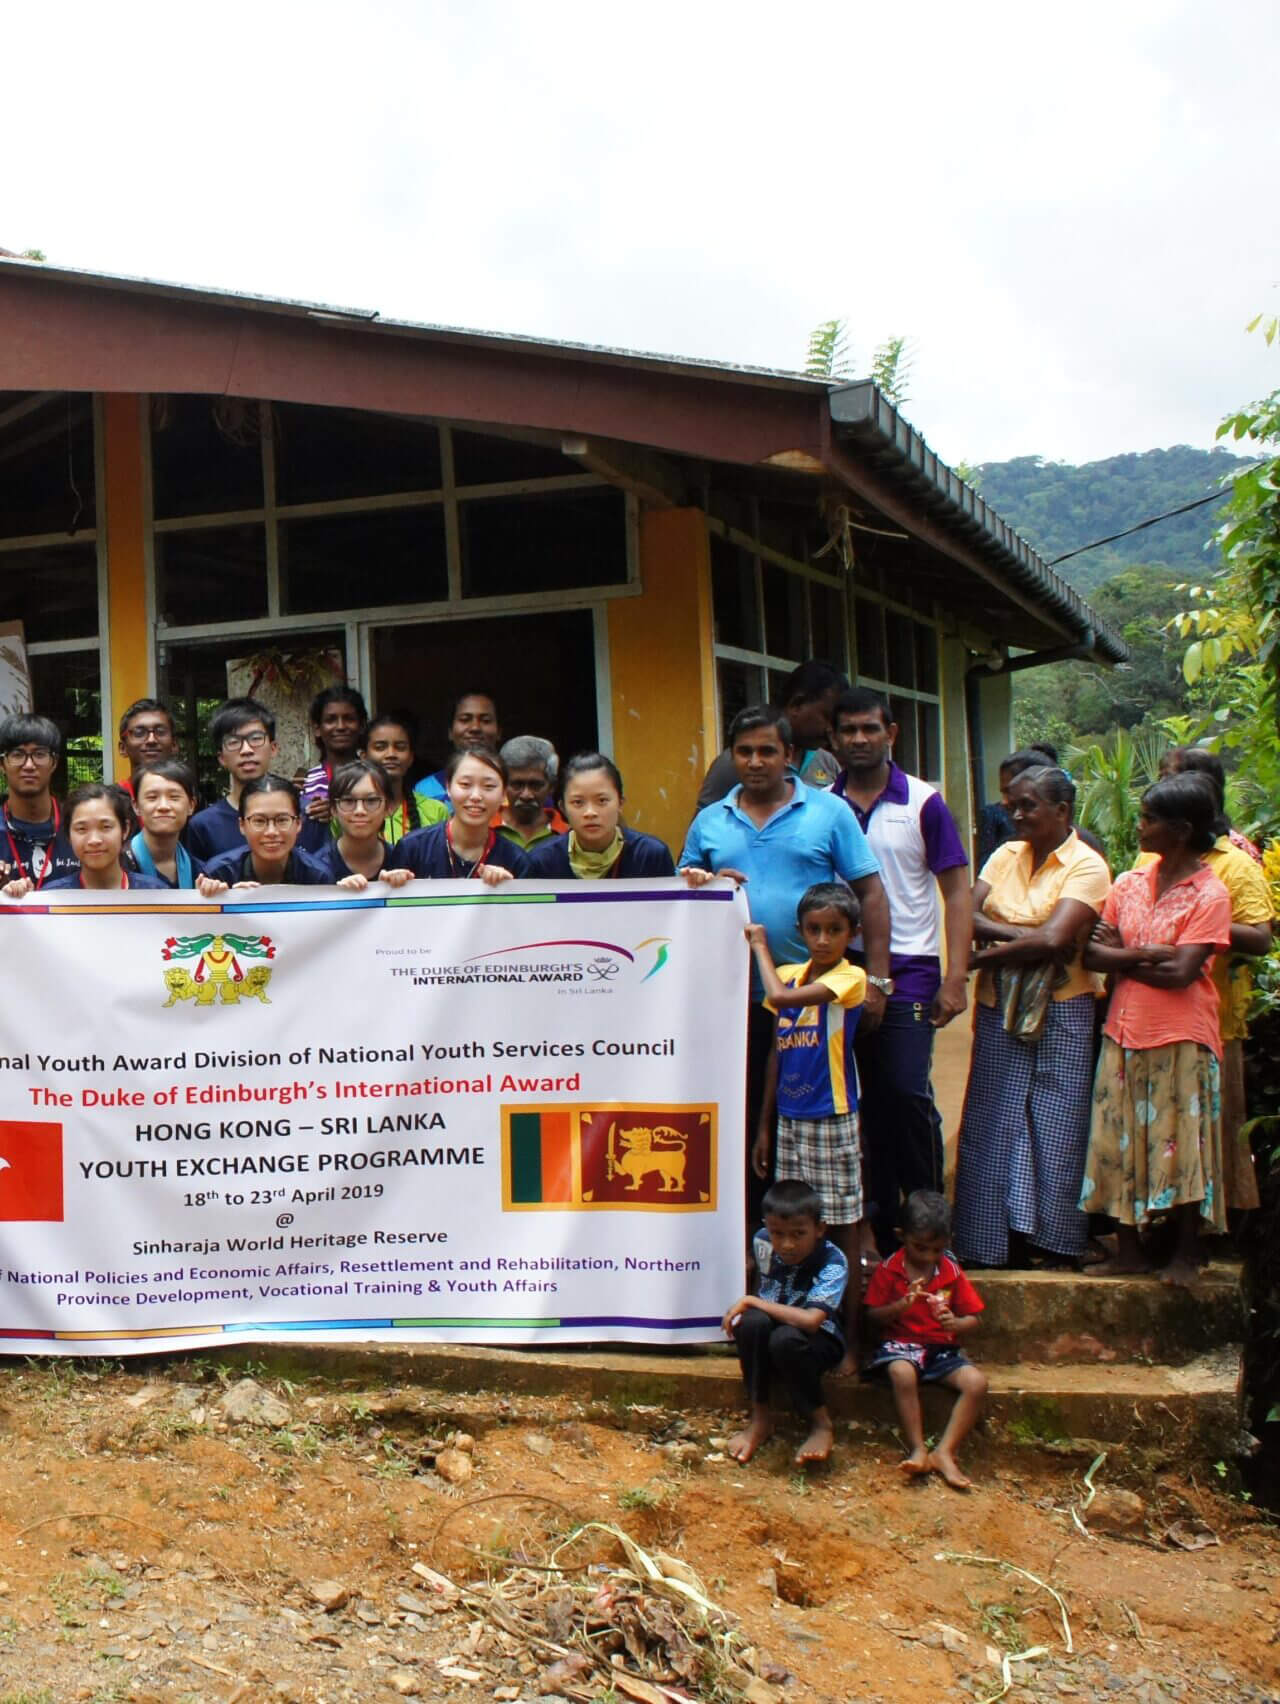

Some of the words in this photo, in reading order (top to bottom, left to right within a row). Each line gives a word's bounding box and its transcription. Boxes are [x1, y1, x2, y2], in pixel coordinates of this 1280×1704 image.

[375, 948, 405, 956] Proud
[419, 947, 432, 955] be
[390, 967, 417, 977] THE
[421, 966, 461, 976] DUKE
[463, 965, 481, 974] OF
[484, 963, 584, 974] EDINBURGH'S
[413, 974, 526, 986] INTERNATIONAL
[528, 972, 584, 983] AWARD
[568, 987, 583, 995] Sri
[583, 987, 614, 995] Lanka
[37, 1055, 104, 1071] Youth
[113, 1052, 186, 1071] Award
[195, 1050, 280, 1068] Division
[289, 1048, 311, 1064] of
[319, 1045, 413, 1063] National
[422, 1042, 484, 1060] Youth
[493, 1041, 584, 1057] Services
[592, 1039, 674, 1055] Council
[29, 1088, 72, 1106] The
[83, 1088, 144, 1106] Duke
[154, 1087, 178, 1105] of
[186, 1081, 327, 1104] Edinburgh's
[336, 1075, 491, 1098] International
[500, 1073, 579, 1092] Award
[136, 1123, 210, 1141] HONG
[220, 1119, 290, 1138] KONG
[321, 1118, 357, 1135] SRI
[368, 1113, 445, 1133] LANKA
[80, 1161, 166, 1179] YOUTH
[177, 1155, 309, 1176] EXCHANGE
[319, 1148, 484, 1171] PROGRAMME
[185, 1191, 218, 1206] 18th
[225, 1194, 244, 1205] to
[251, 1188, 285, 1204] 23rd
[292, 1187, 335, 1205] April
[342, 1184, 383, 1199] 2019
[276, 1213, 294, 1228] @
[134, 1239, 219, 1255] Sinharaja
[227, 1236, 283, 1251] World
[291, 1234, 367, 1248] Heritage
[375, 1231, 447, 1243] Reserve
[8, 1271, 78, 1284] National
[86, 1272, 148, 1284] Policies
[154, 1268, 183, 1281] and
[190, 1266, 270, 1279] Economic
[276, 1263, 334, 1276] Affairs,
[341, 1259, 453, 1272] Resettlement
[460, 1258, 490, 1270] and
[498, 1257, 618, 1271] Rehabilitation,
[625, 1258, 700, 1271] Northern
[58, 1293, 130, 1305] Province
[137, 1288, 253, 1304] Development,
[259, 1282, 347, 1297] Vocational
[354, 1281, 422, 1295] Training
[428, 1280, 440, 1292] &
[447, 1280, 496, 1292] Youth
[503, 1280, 557, 1292] Affairs
